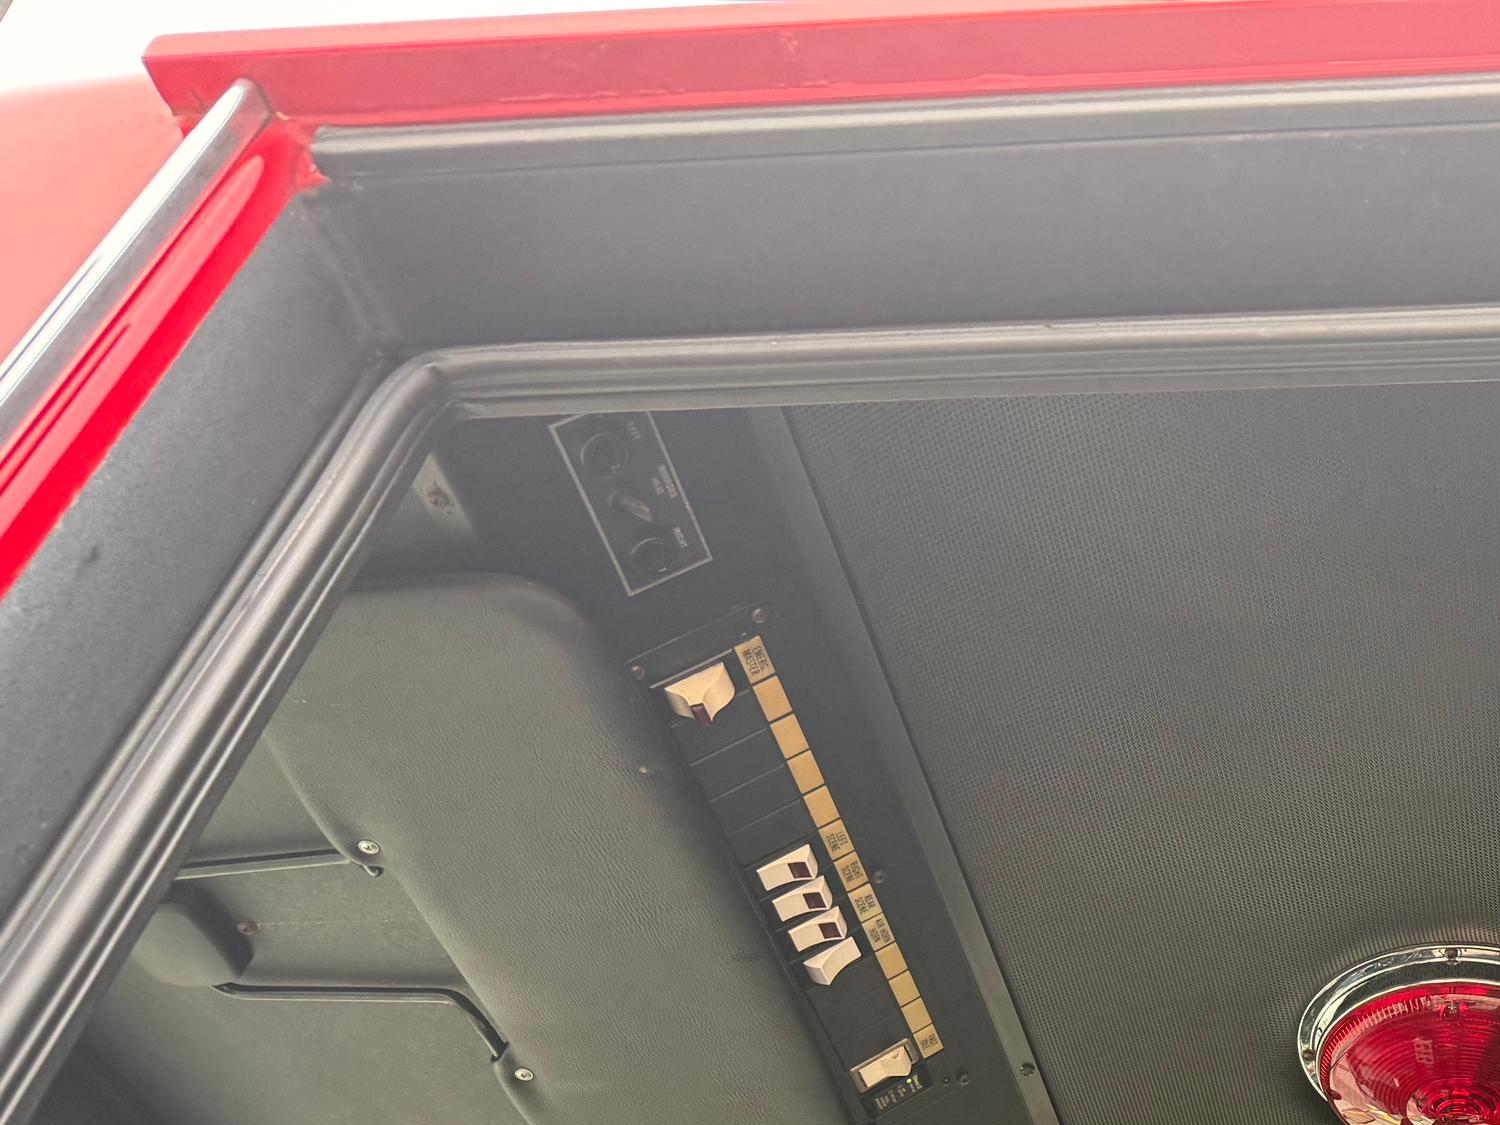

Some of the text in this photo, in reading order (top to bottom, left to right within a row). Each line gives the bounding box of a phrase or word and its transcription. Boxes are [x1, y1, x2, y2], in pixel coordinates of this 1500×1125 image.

[741, 648, 760, 676] MASTER
[824, 832, 841, 852] SCENE
[834, 830, 848, 846] LEFT
